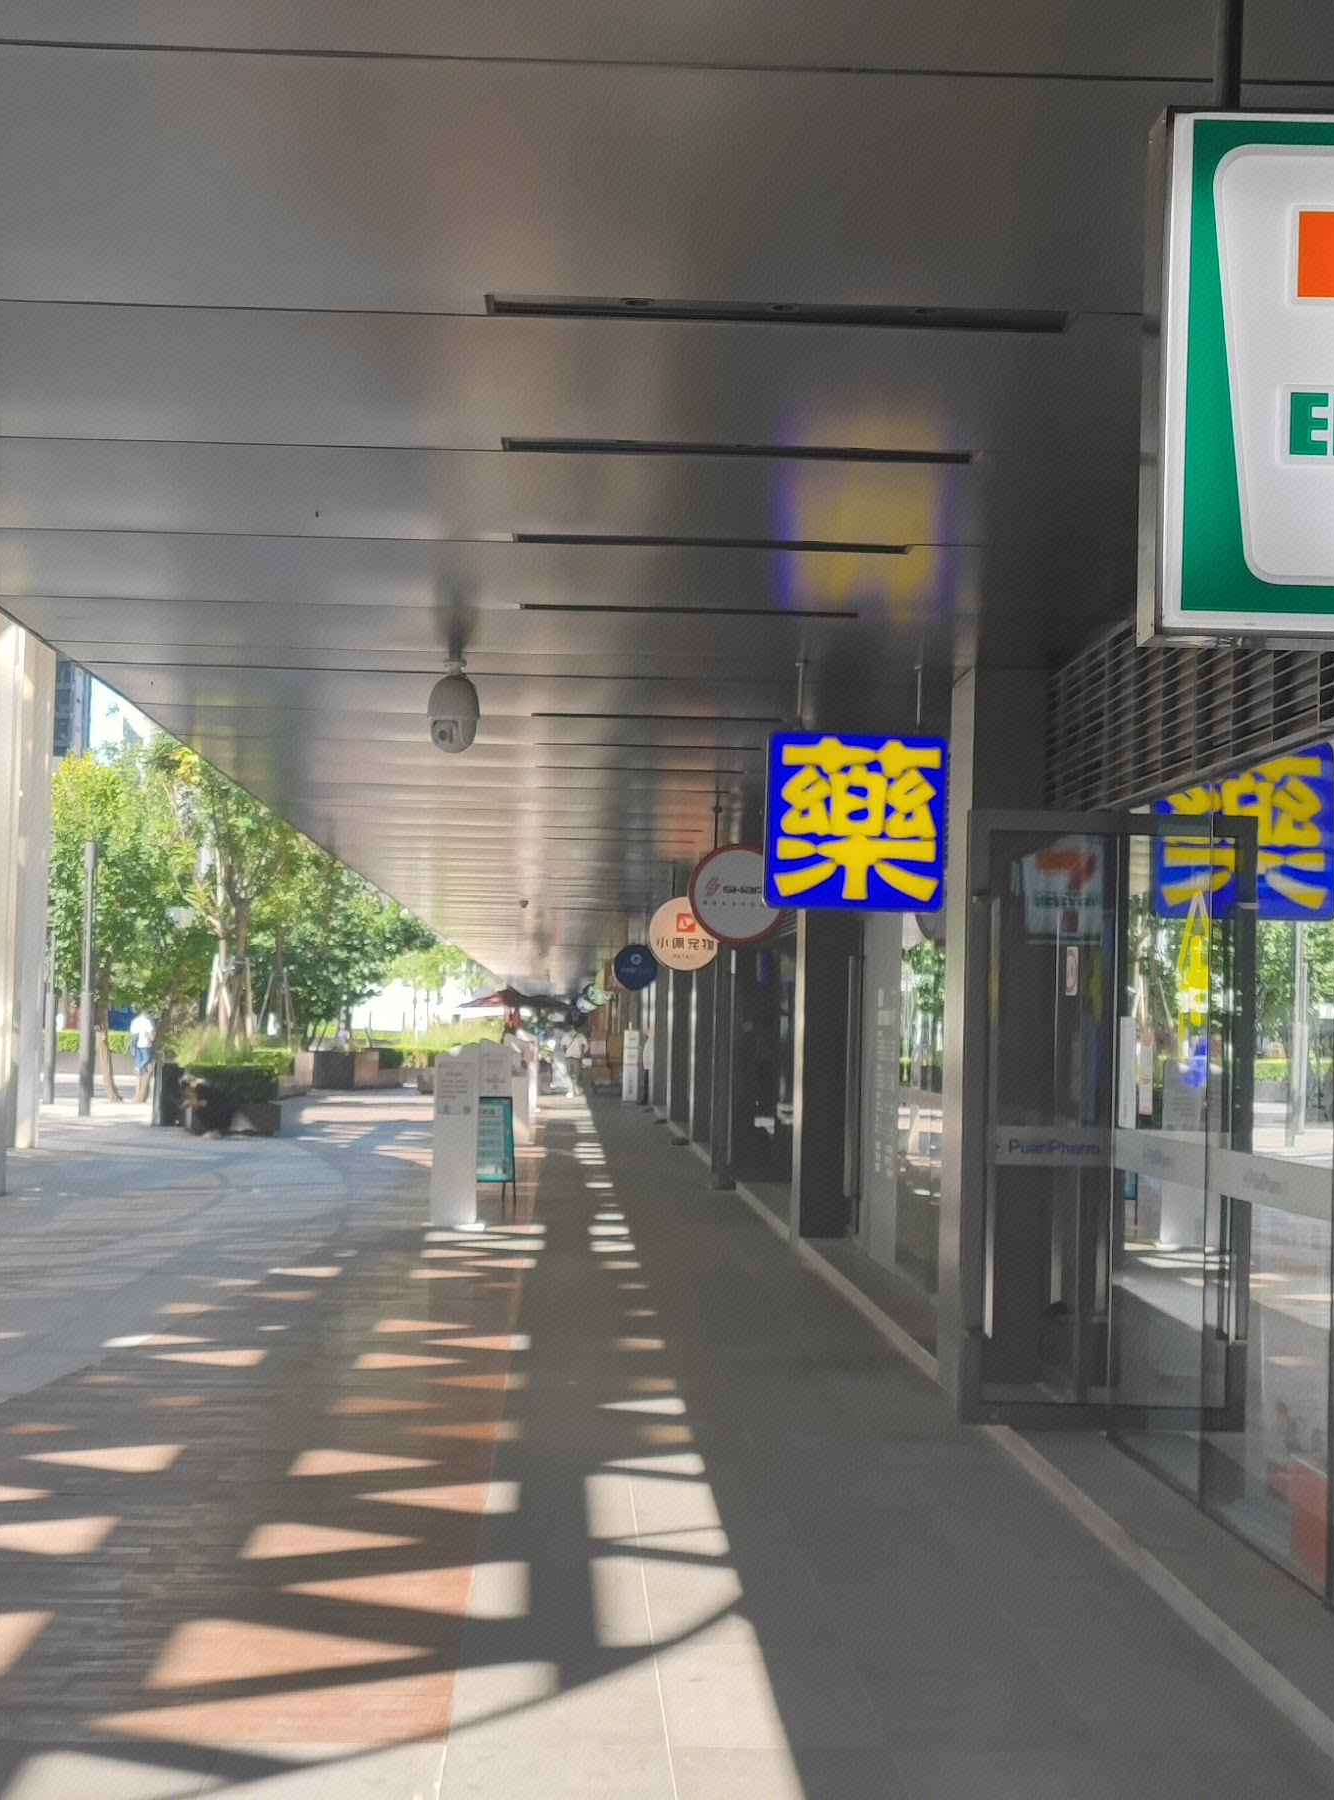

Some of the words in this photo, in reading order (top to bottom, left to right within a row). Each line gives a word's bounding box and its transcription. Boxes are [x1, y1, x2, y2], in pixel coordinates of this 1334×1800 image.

[773, 737, 942, 902] 藥
[655, 936, 715, 952] 小佩宠物
